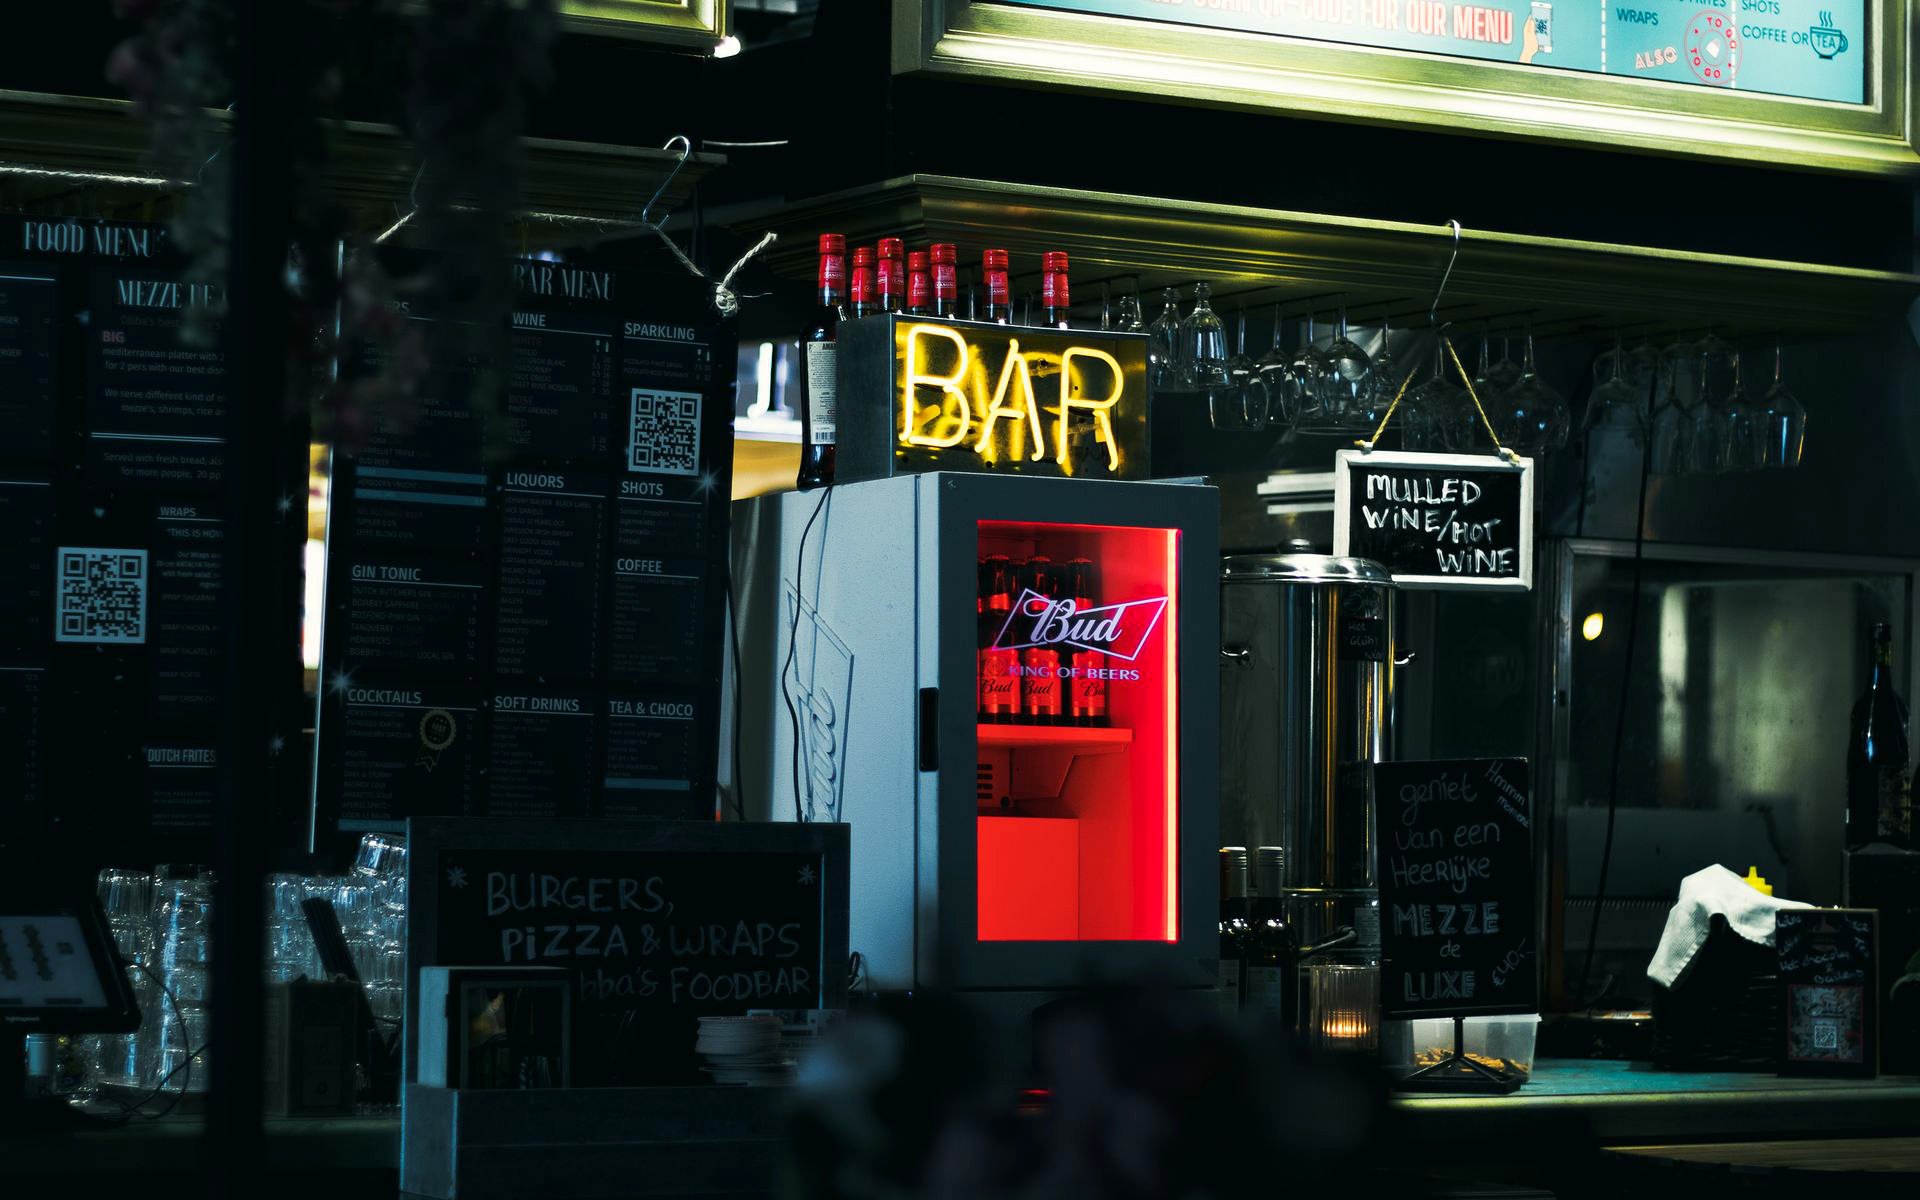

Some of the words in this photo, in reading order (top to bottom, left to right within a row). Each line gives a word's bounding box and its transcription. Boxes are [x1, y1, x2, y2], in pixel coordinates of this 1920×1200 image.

[1616, 8, 1659, 26] WRAPS
[1742, 0, 1781, 15] SHOTS
[1404, 1, 1447, 36] OUR
[1453, 5, 1513, 44] MENU
[1742, 24, 1787, 43] COFFEE
[1791, 31, 1808, 46] OR
[1815, 34, 1837, 50] TEA
[1635, 46, 1678, 69] ALSO
[23, 221, 84, 253] FOOD
[93, 225, 157, 257] MENU
[118, 279, 182, 308] MEZZE
[560, 270, 615, 301] MENU
[513, 313, 546, 327] WINE
[102, 331, 125, 342] BIG
[624, 322, 695, 340] SPARKLING
[899, 324, 1124, 472] BAR
[506, 473, 564, 489] LIQUORS
[619, 481, 664, 497] SHOTS
[1367, 474, 1481, 505] MULLED
[160, 506, 197, 518] WRAPS
[352, 564, 376, 579] GIN
[379, 566, 422, 581] TONIC
[616, 558, 662, 574] COFFEE
[1023, 598, 1127, 643] Bud
[1009, 665, 1050, 677] KING
[1057, 667, 1081, 678] OF
[1087, 668, 1140, 681] BEERS
[982, 679, 1014, 694] Bud
[1024, 680, 1054, 695] Bud
[347, 688, 423, 705] COCKTAILS
[494, 696, 528, 709] SOFT
[531, 697, 579, 712] DRINKS
[609, 701, 633, 714] TEA
[636, 702, 647, 714] &
[650, 703, 694, 717] CHOCO
[147, 748, 180, 763] DUTCH
[182, 749, 216, 764] FRITES
[1400, 771, 1477, 826] geniet
[1395, 828, 1443, 851] van
[1453, 821, 1500, 848] een
[486, 870, 675, 919] BURGERS,
[1392, 901, 1501, 937] MEZZE
[641, 924, 661, 956] &
[669, 919, 800, 958] WRAPS
[1440, 938, 1462, 958] de
[669, 966, 811, 1004] FOODBAR
[1403, 970, 1476, 1002] LUXE
